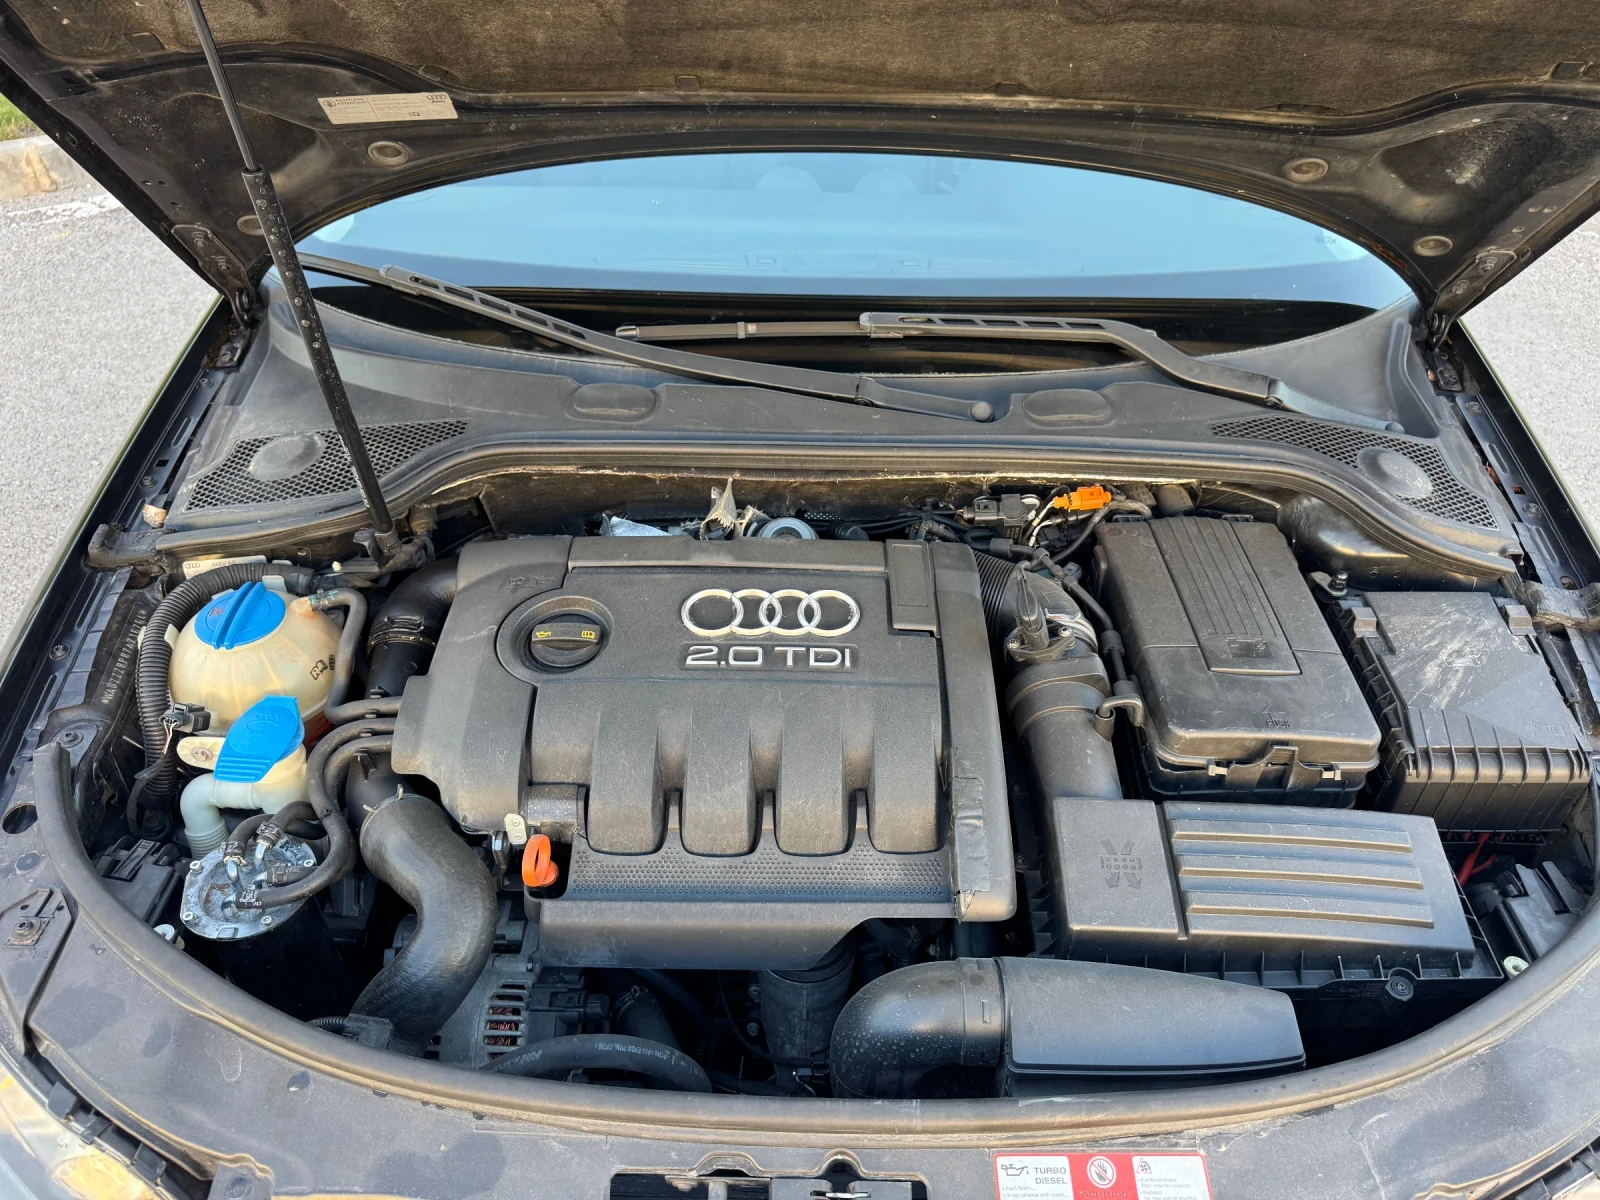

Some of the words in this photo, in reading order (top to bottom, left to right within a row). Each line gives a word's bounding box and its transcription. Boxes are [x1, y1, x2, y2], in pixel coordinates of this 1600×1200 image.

[684, 645, 765, 668] 2.0
[774, 646, 852, 670] TDI
[1034, 1166, 1067, 1175] TURBO
[1035, 1177, 1068, 1185] DIESEL
[1082, 1191, 1129, 1199] ACHTUNG
